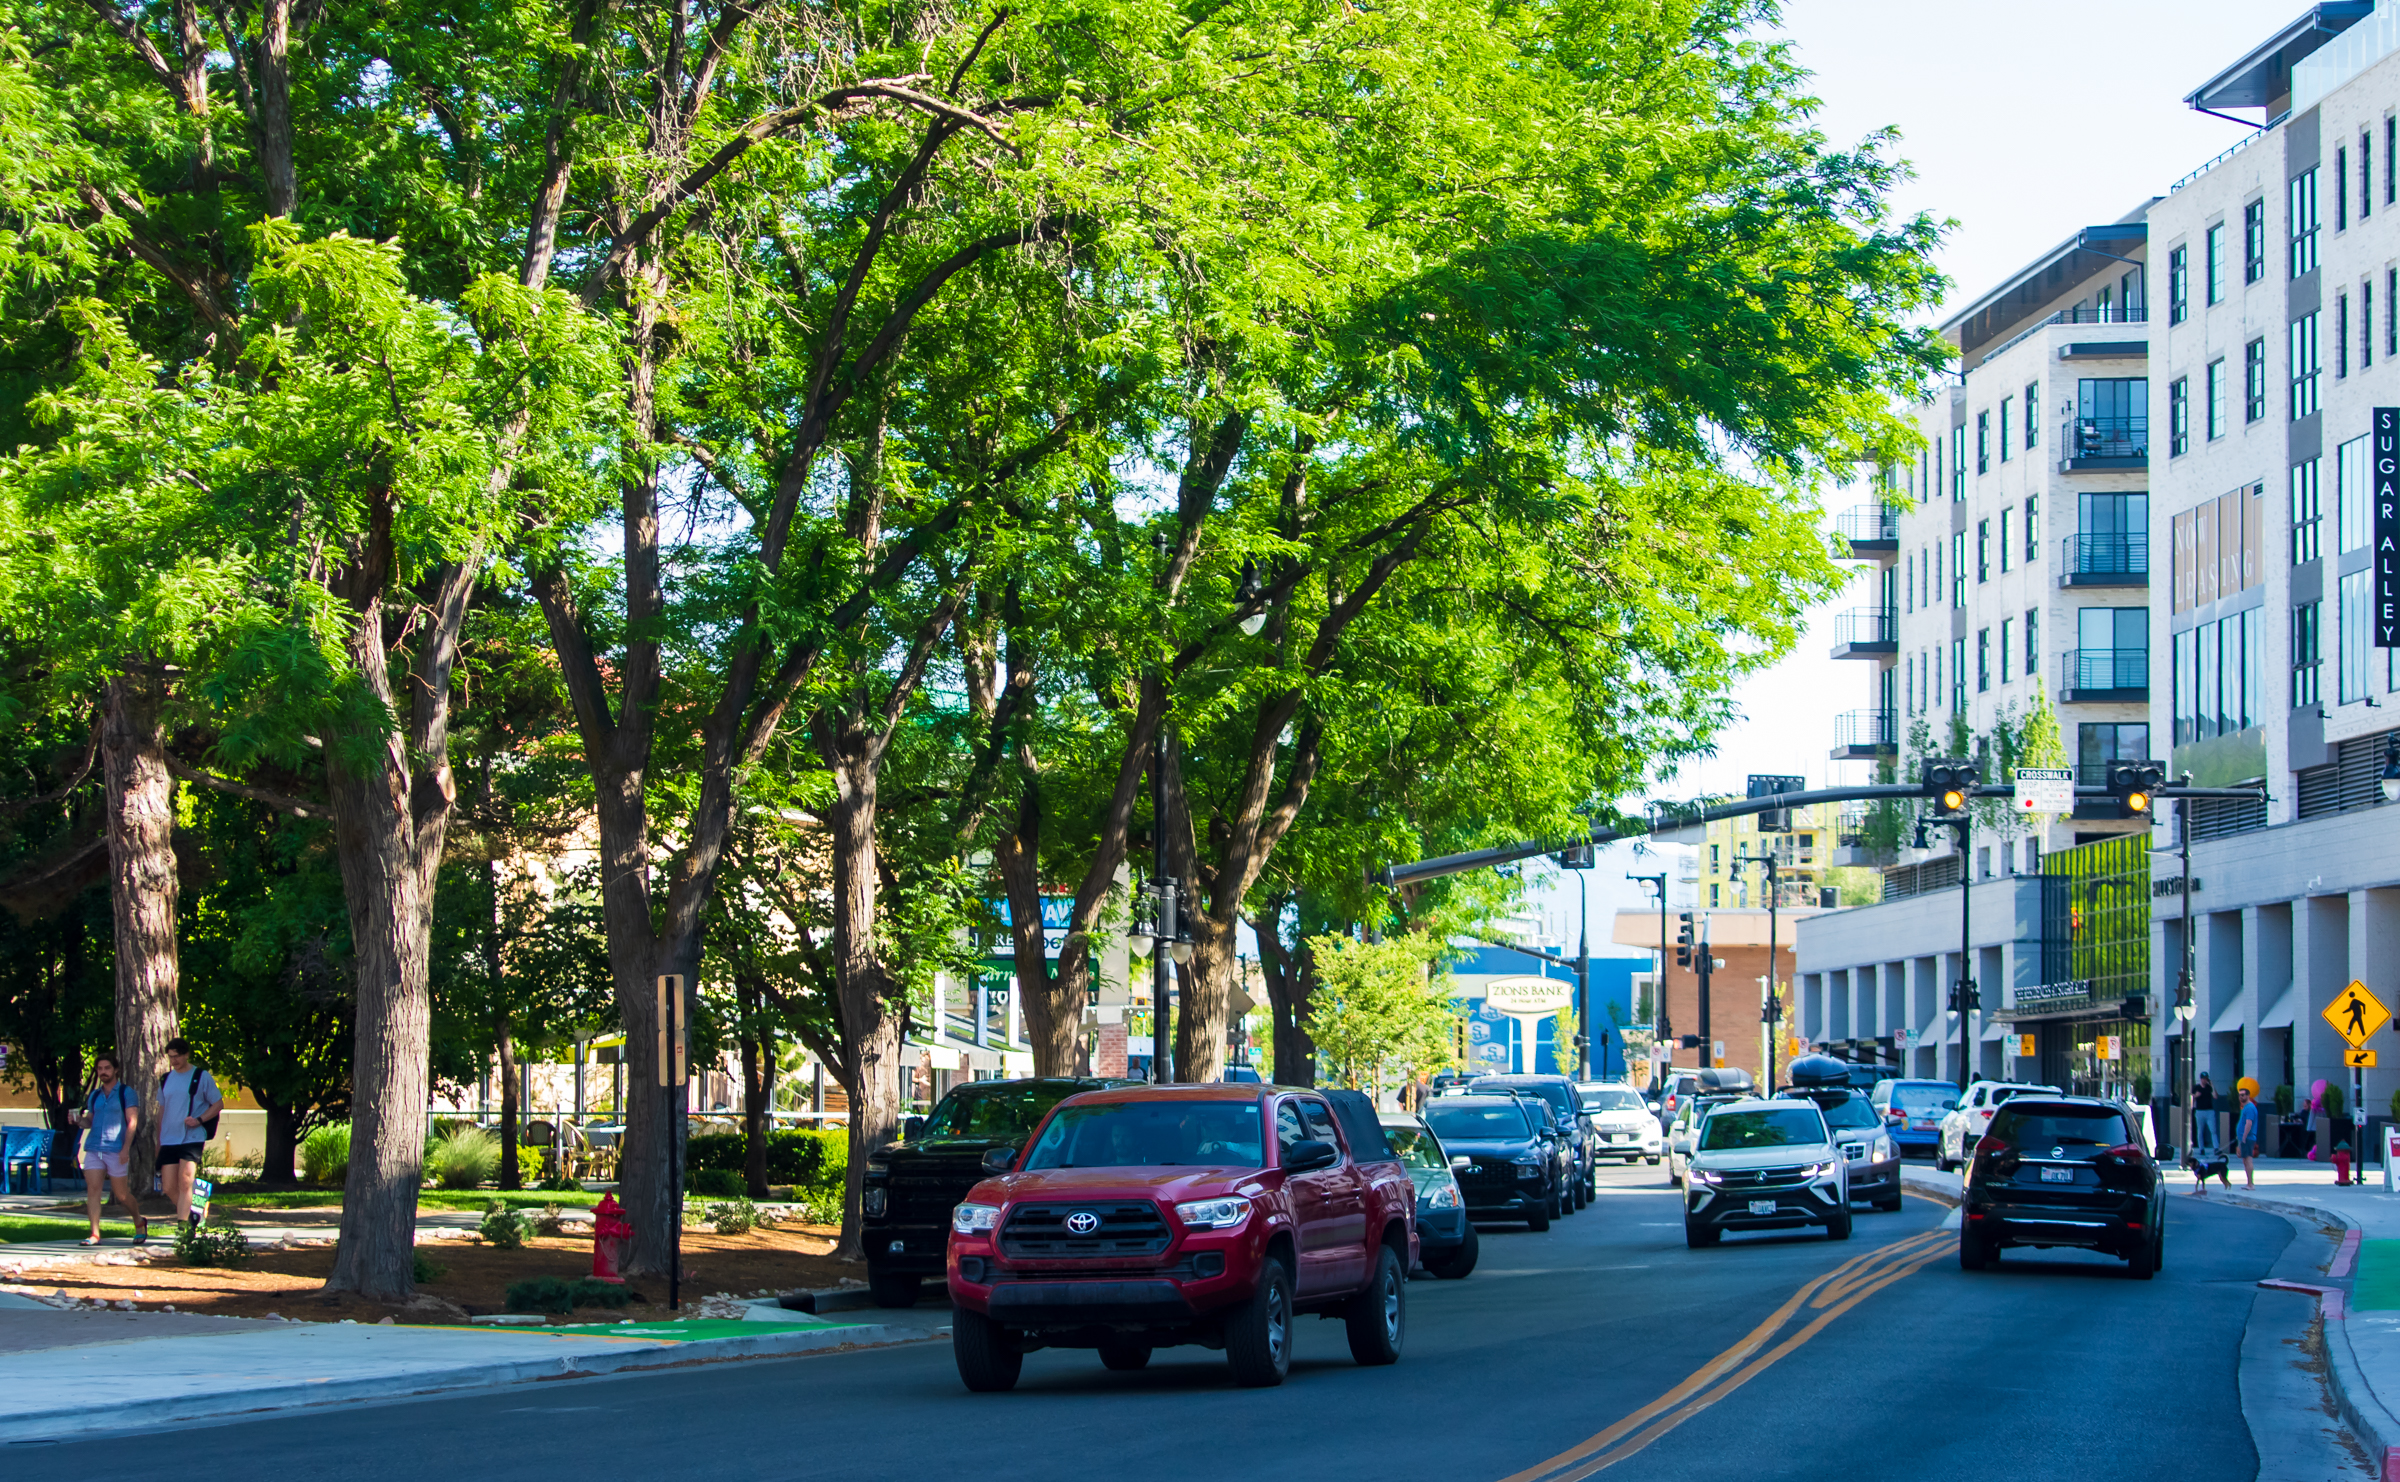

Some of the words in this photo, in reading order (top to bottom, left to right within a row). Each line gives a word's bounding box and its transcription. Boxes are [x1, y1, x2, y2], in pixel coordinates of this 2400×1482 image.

[2378, 413, 2396, 519] SUGAR
[2175, 515, 2208, 556] NOW
[2175, 548, 2252, 604] LEASING
[2380, 536, 2395, 642] ALLEY
[2020, 770, 2069, 780] CROSSWALK
[1492, 986, 1528, 996] ZIONS
[1531, 986, 1564, 996] BANK
